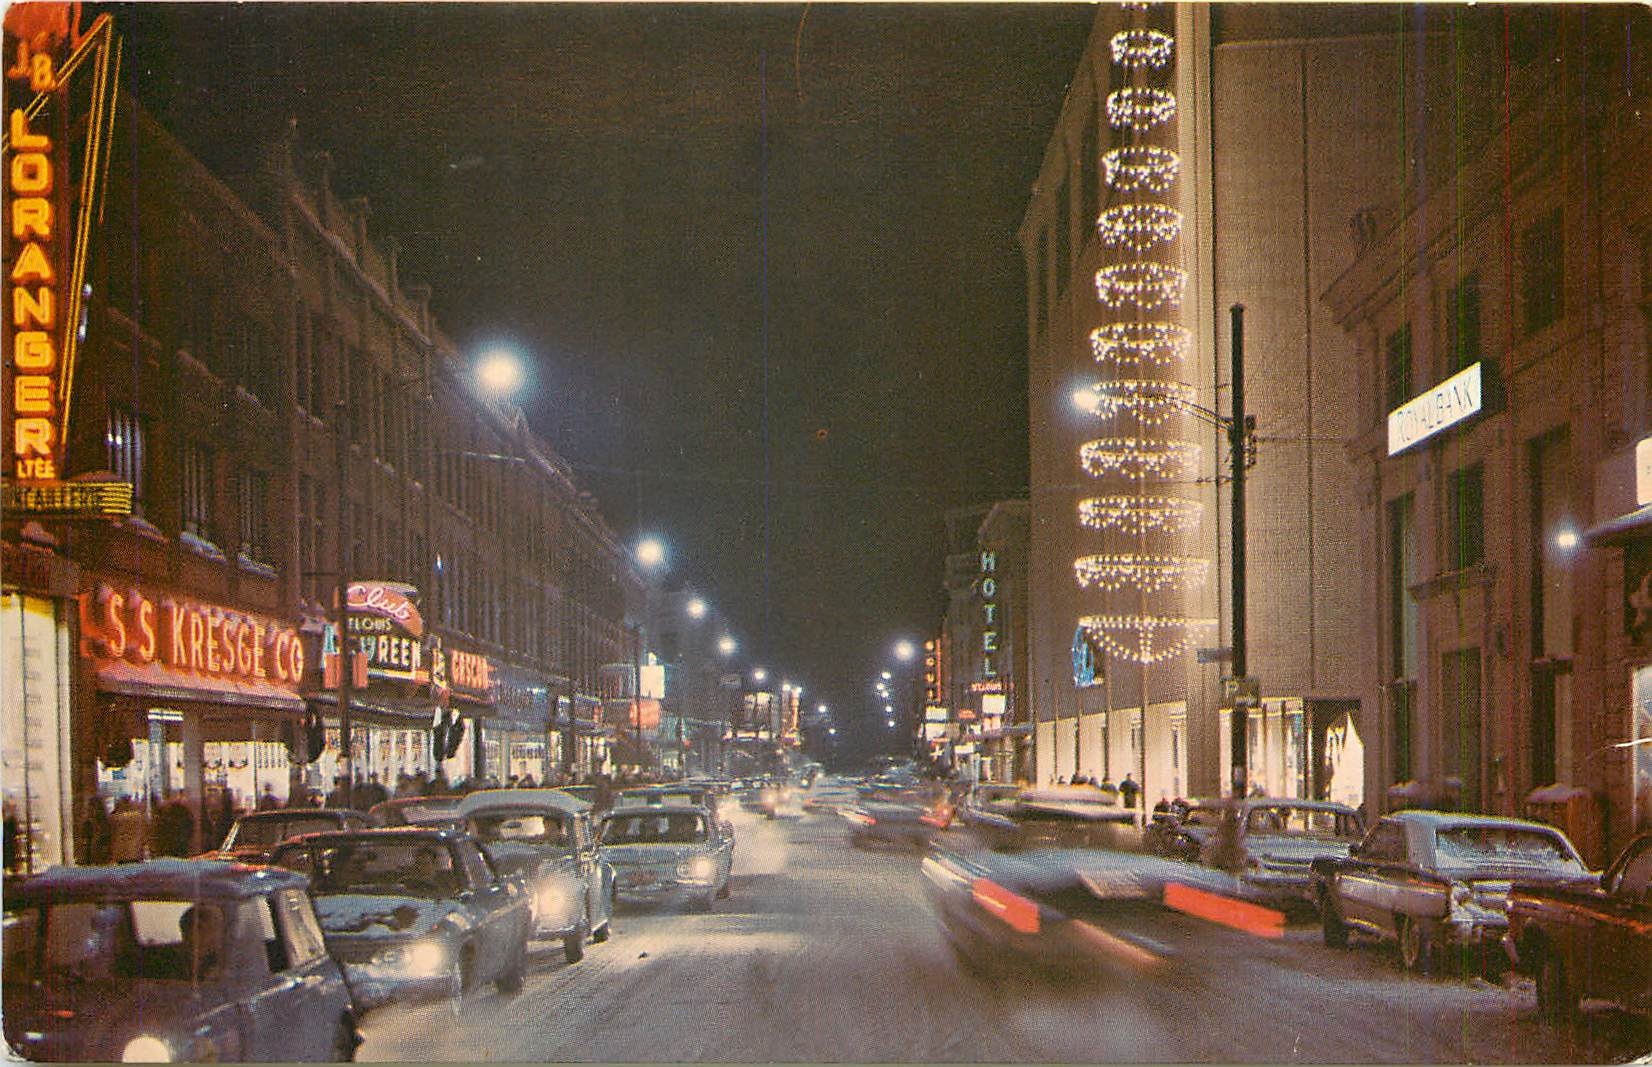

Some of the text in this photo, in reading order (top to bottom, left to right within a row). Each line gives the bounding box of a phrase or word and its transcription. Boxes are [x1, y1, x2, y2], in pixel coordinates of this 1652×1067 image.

[9, 107, 55, 456] LORANGER
[109, 593, 304, 682] S S KRESGE CO
[346, 584, 411, 620] Club
[980, 550, 998, 677] HOTEL
